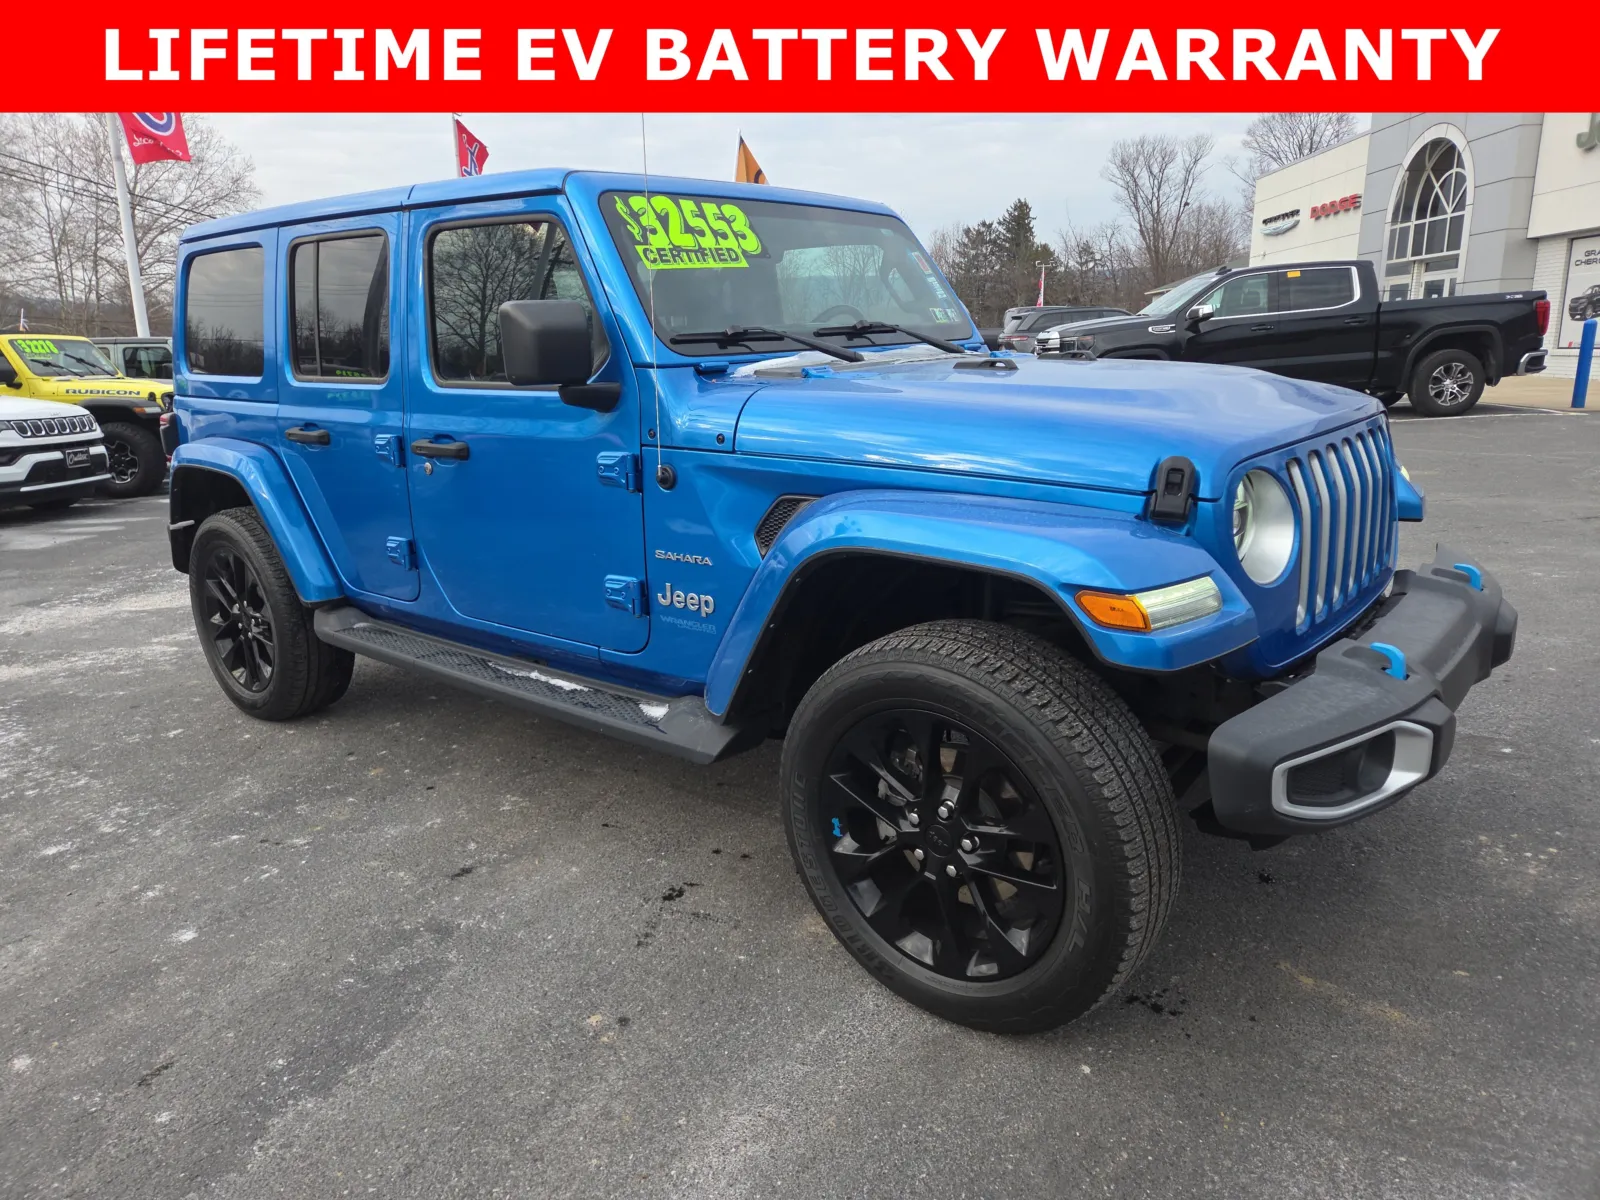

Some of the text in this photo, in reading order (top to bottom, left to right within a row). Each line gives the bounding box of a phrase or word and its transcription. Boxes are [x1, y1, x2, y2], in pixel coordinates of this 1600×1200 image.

[1309, 193, 1362, 219] DODGE
[613, 195, 762, 255] $32553
[640, 247, 743, 266] CERTIFIED
[1575, 257, 1600, 267] CHER
[65, 388, 141, 396] RUBICON
[655, 549, 713, 566] SAHARA
[657, 582, 715, 618] Jeep
[660, 614, 717, 630] WRANGLER
